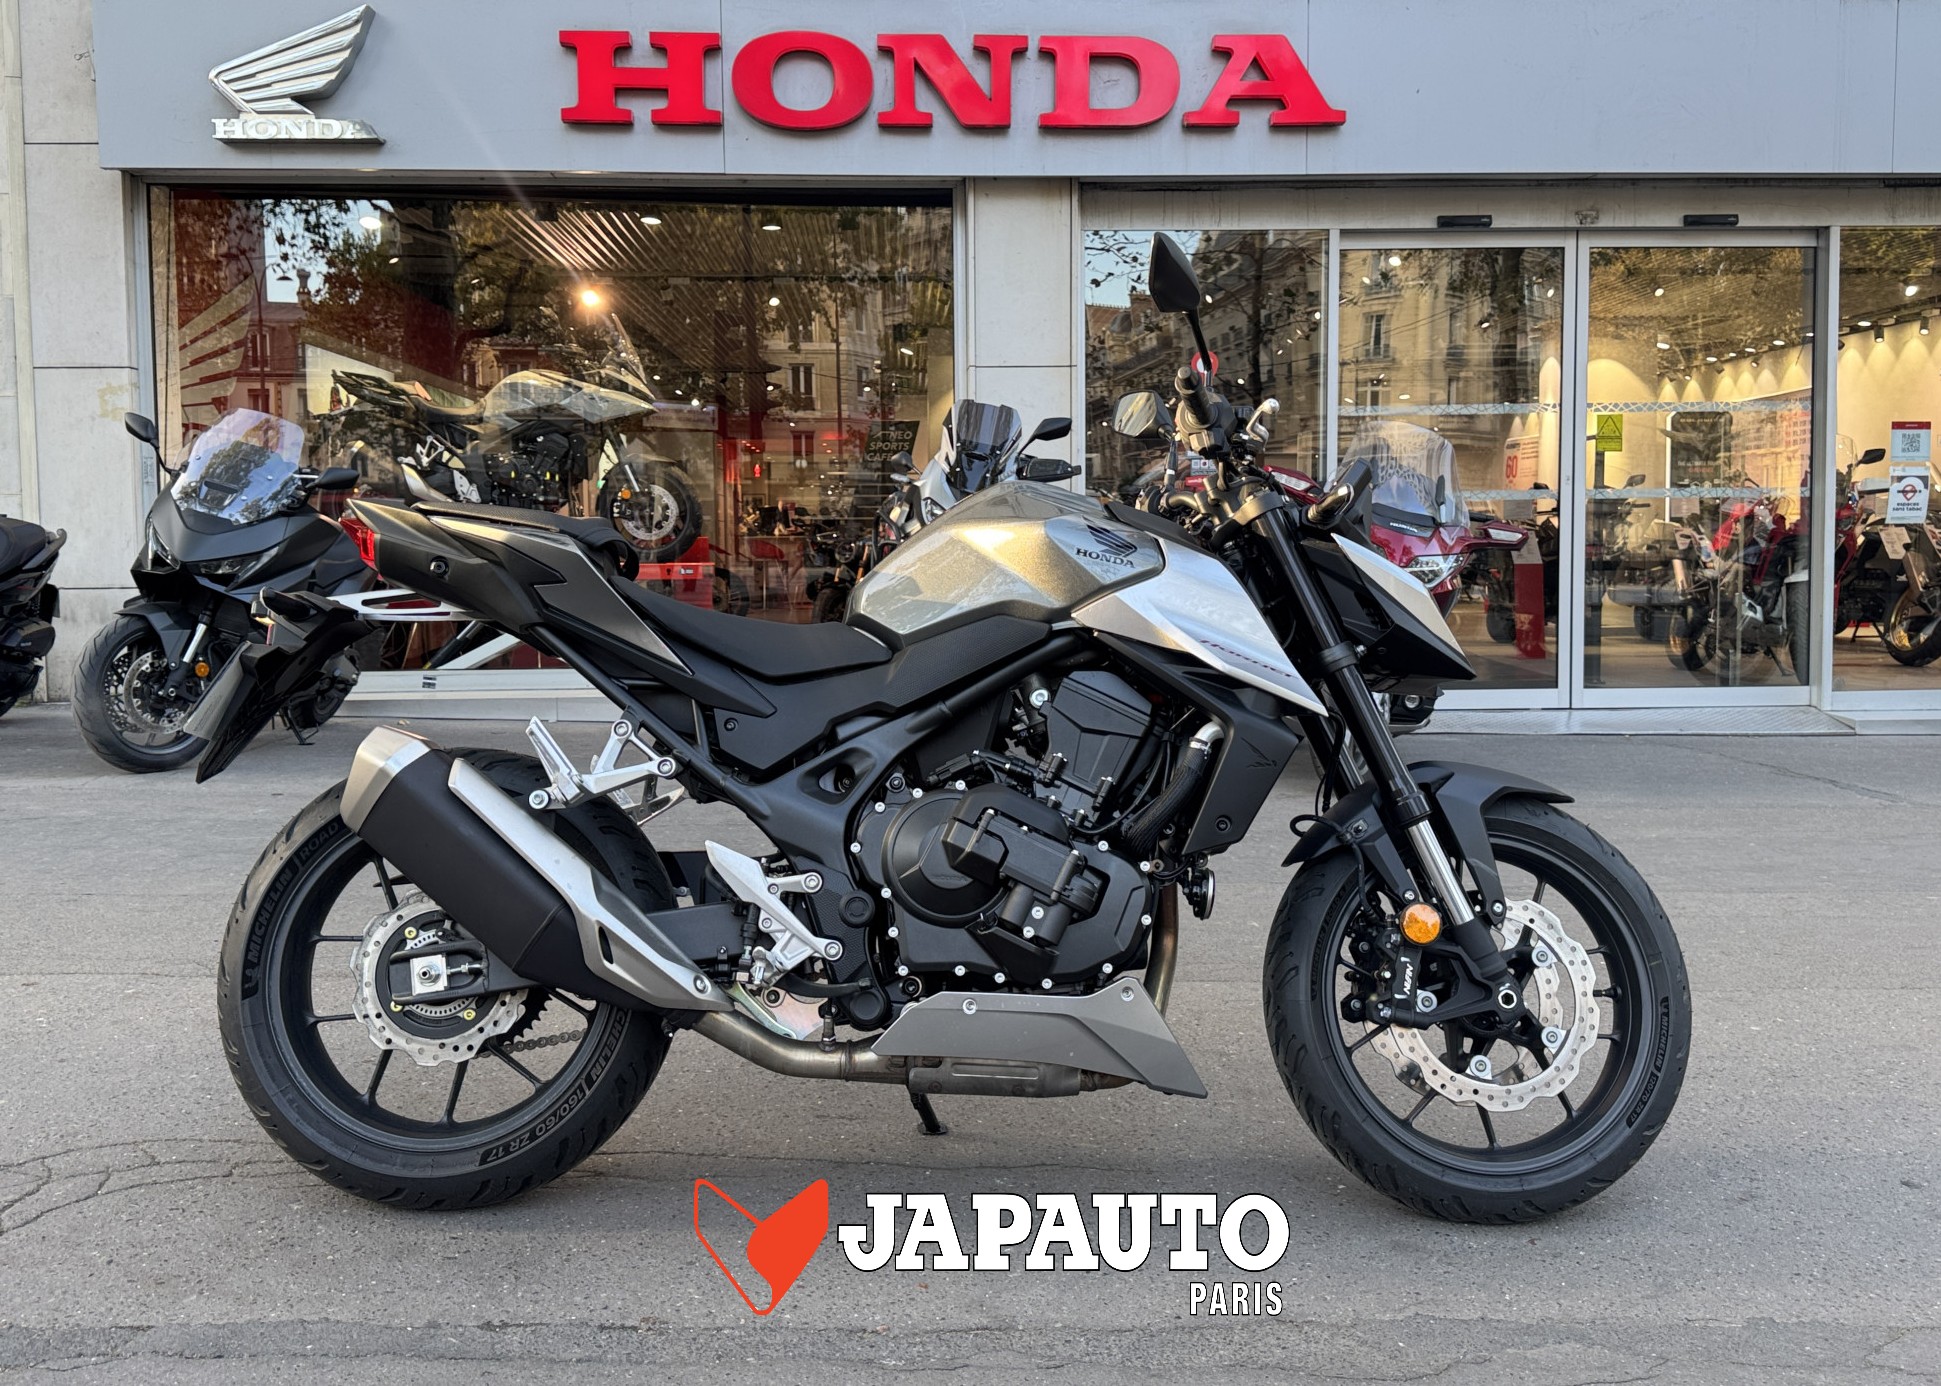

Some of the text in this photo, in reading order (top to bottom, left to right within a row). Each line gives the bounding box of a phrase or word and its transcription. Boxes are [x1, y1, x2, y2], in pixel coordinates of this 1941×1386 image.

[558, 30, 1347, 131] HONDA
[211, 118, 379, 139] HONDA
[869, 442, 910, 450] SPORTS
[888, 431, 913, 440] NEO
[1075, 547, 1136, 568] HONDA
[247, 821, 339, 964] MICHELIN ROAD
[1655, 1015, 1669, 1068] MICHELIN
[487, 1007, 629, 1162] CHELIN 160/60 ZR 17
[1642, 1075, 1657, 1101] 120/70
